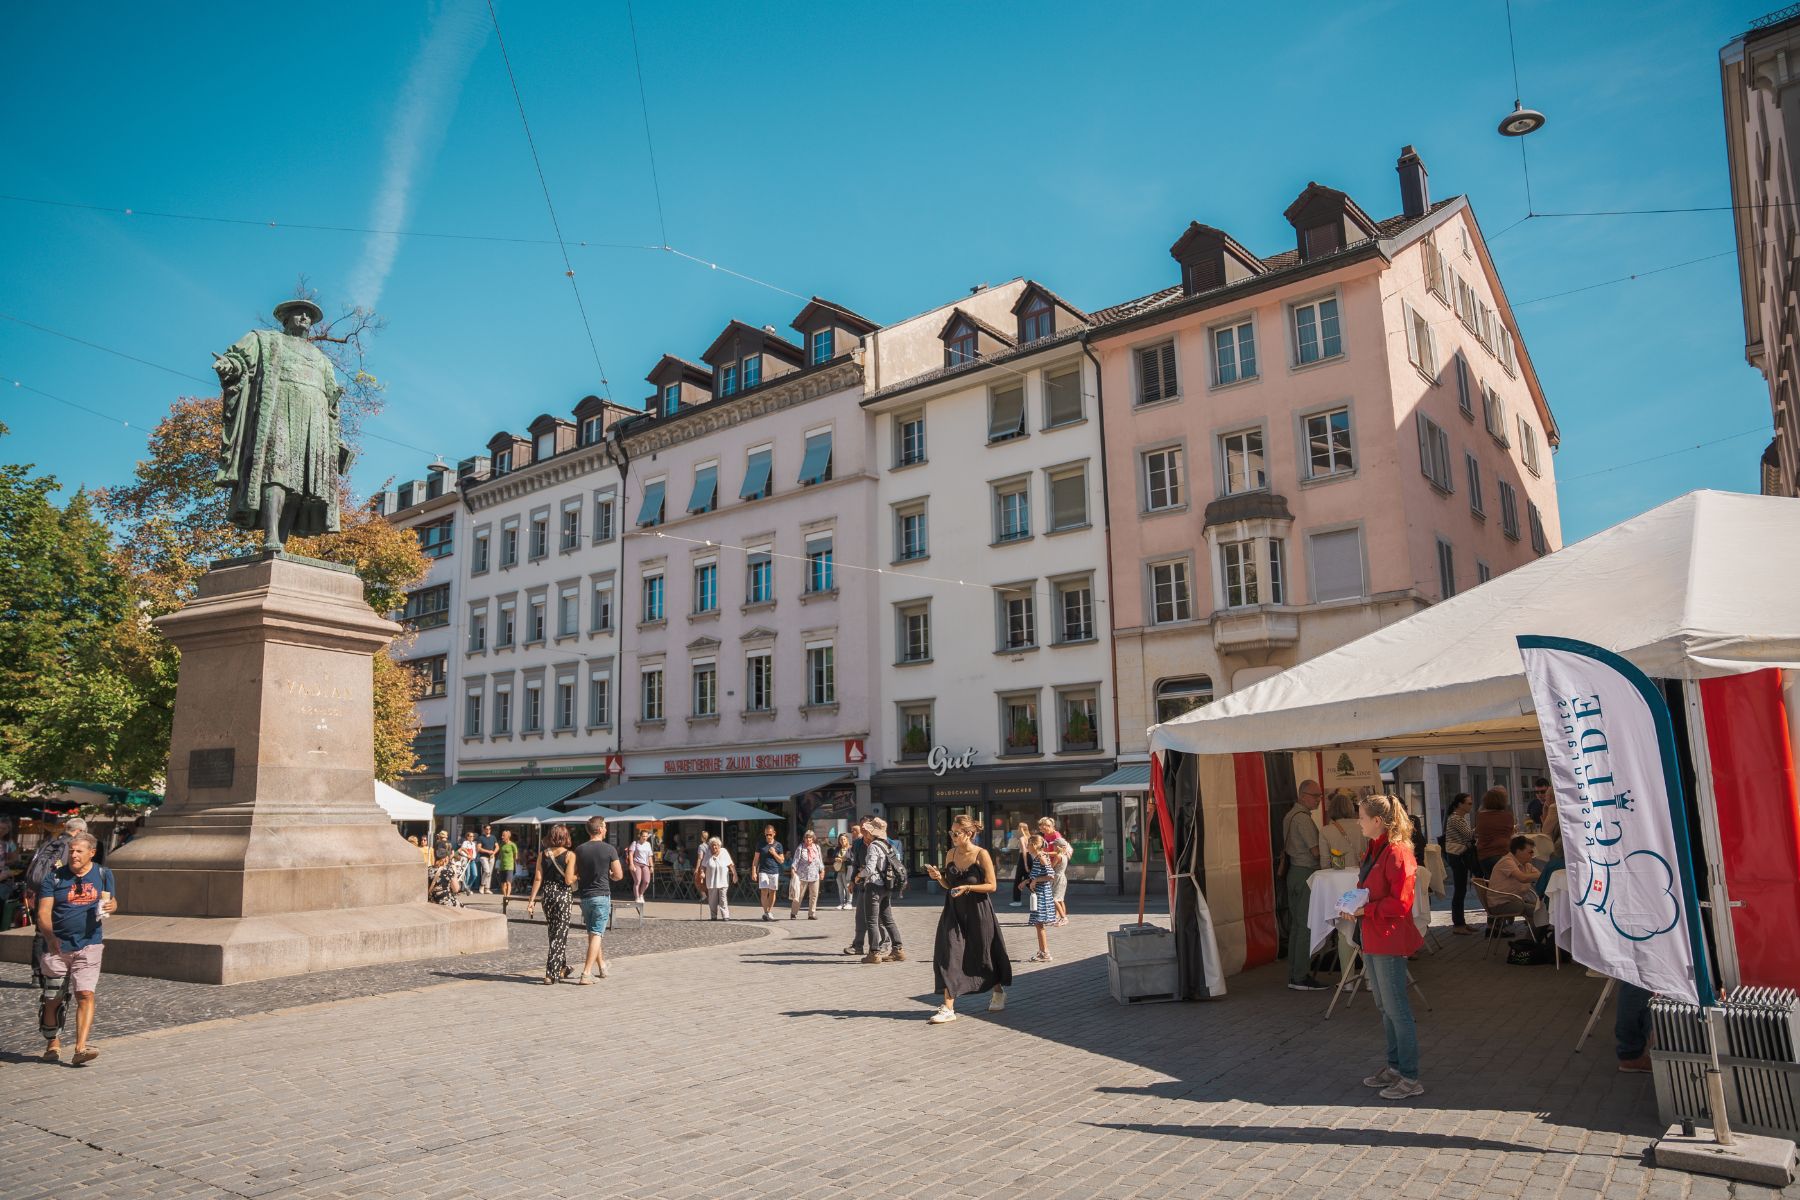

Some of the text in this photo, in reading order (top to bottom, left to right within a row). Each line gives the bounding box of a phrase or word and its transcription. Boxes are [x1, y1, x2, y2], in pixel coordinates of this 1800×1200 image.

[664, 753, 800, 773] PAPETERIE ZUM SCHIFF
[928, 745, 977, 777] Gut
